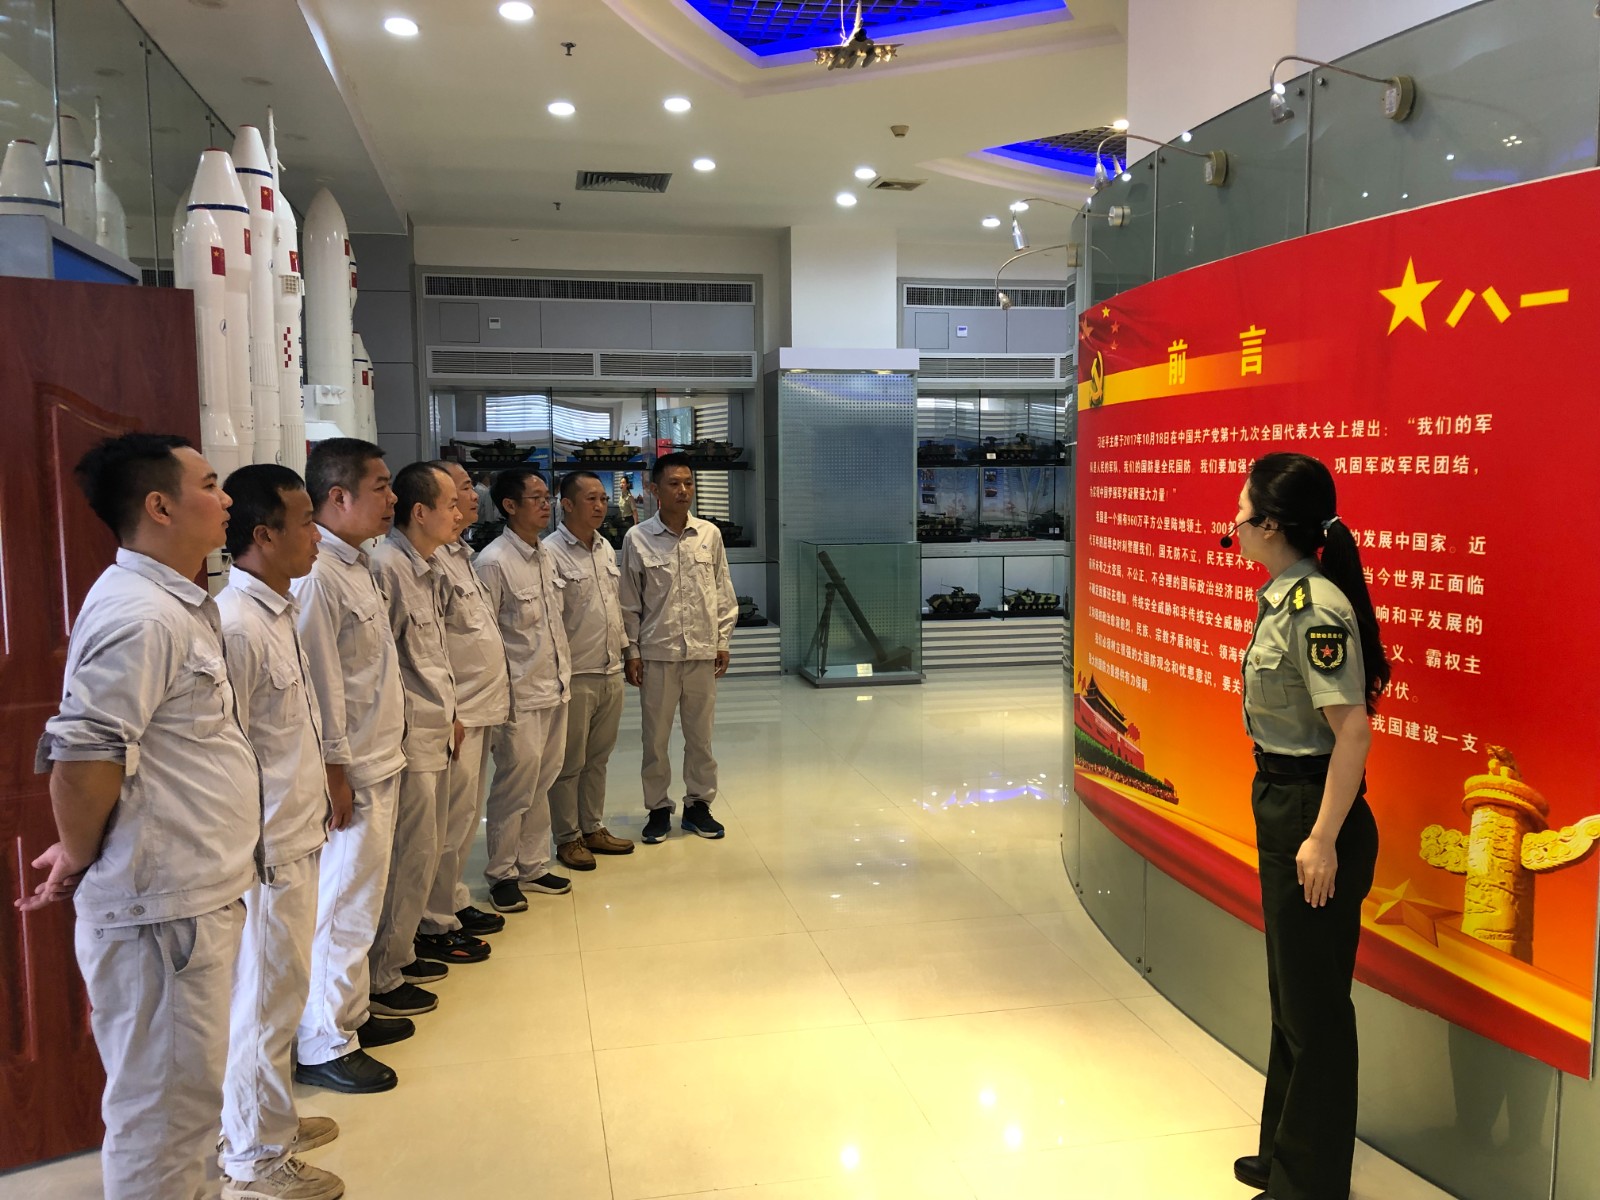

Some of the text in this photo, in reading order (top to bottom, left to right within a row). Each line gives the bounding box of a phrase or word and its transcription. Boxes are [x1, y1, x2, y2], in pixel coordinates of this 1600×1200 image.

[1446, 286, 1569, 328] 八一
[1167, 324, 1266, 386] 前言
[1371, 713, 1479, 753] 我国建设一支
